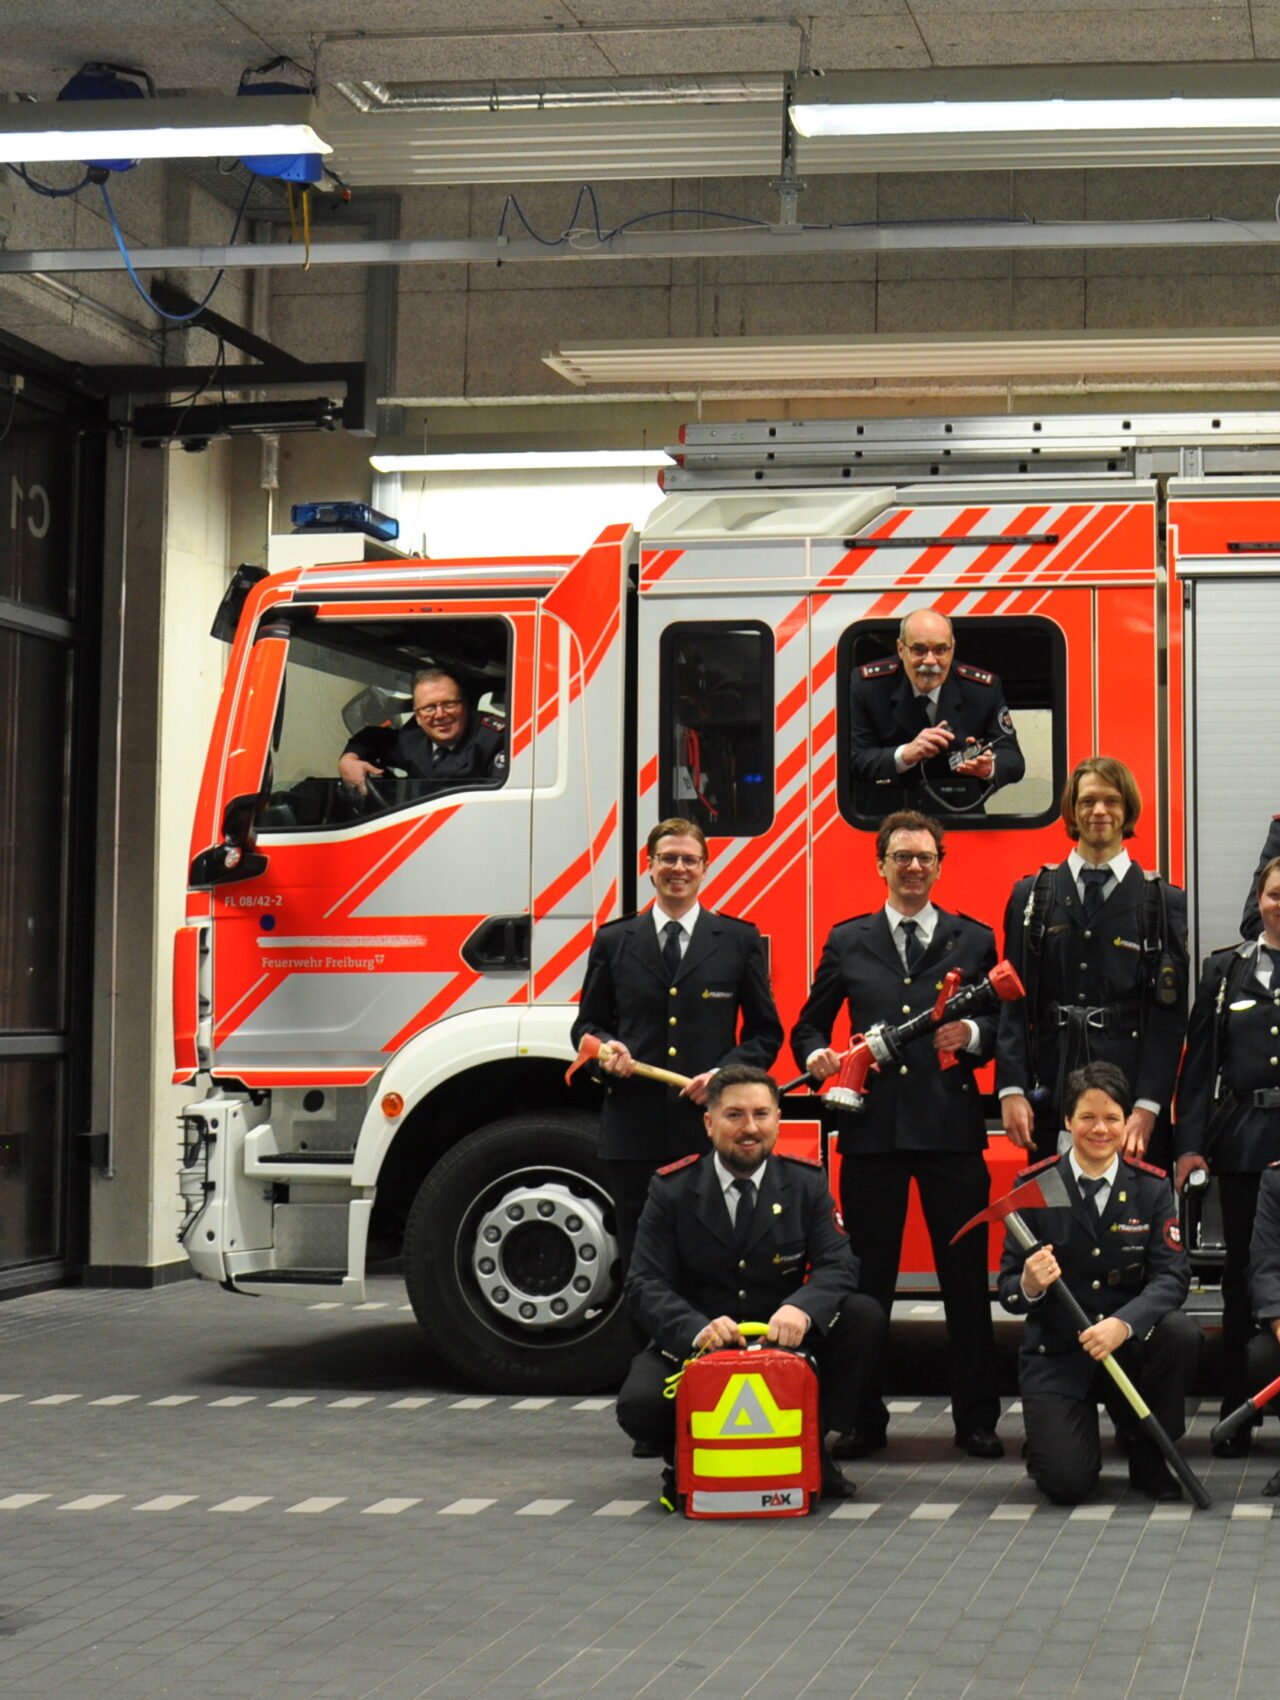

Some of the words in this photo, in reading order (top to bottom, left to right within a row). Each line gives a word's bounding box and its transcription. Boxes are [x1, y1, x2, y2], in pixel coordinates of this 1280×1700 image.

[224, 896, 236, 907] FL
[239, 895, 283, 907] 08/42-2
[261, 956, 323, 968] Feuerwehr
[325, 956, 375, 971] Freiburg
[761, 1492, 792, 1507] PAX
